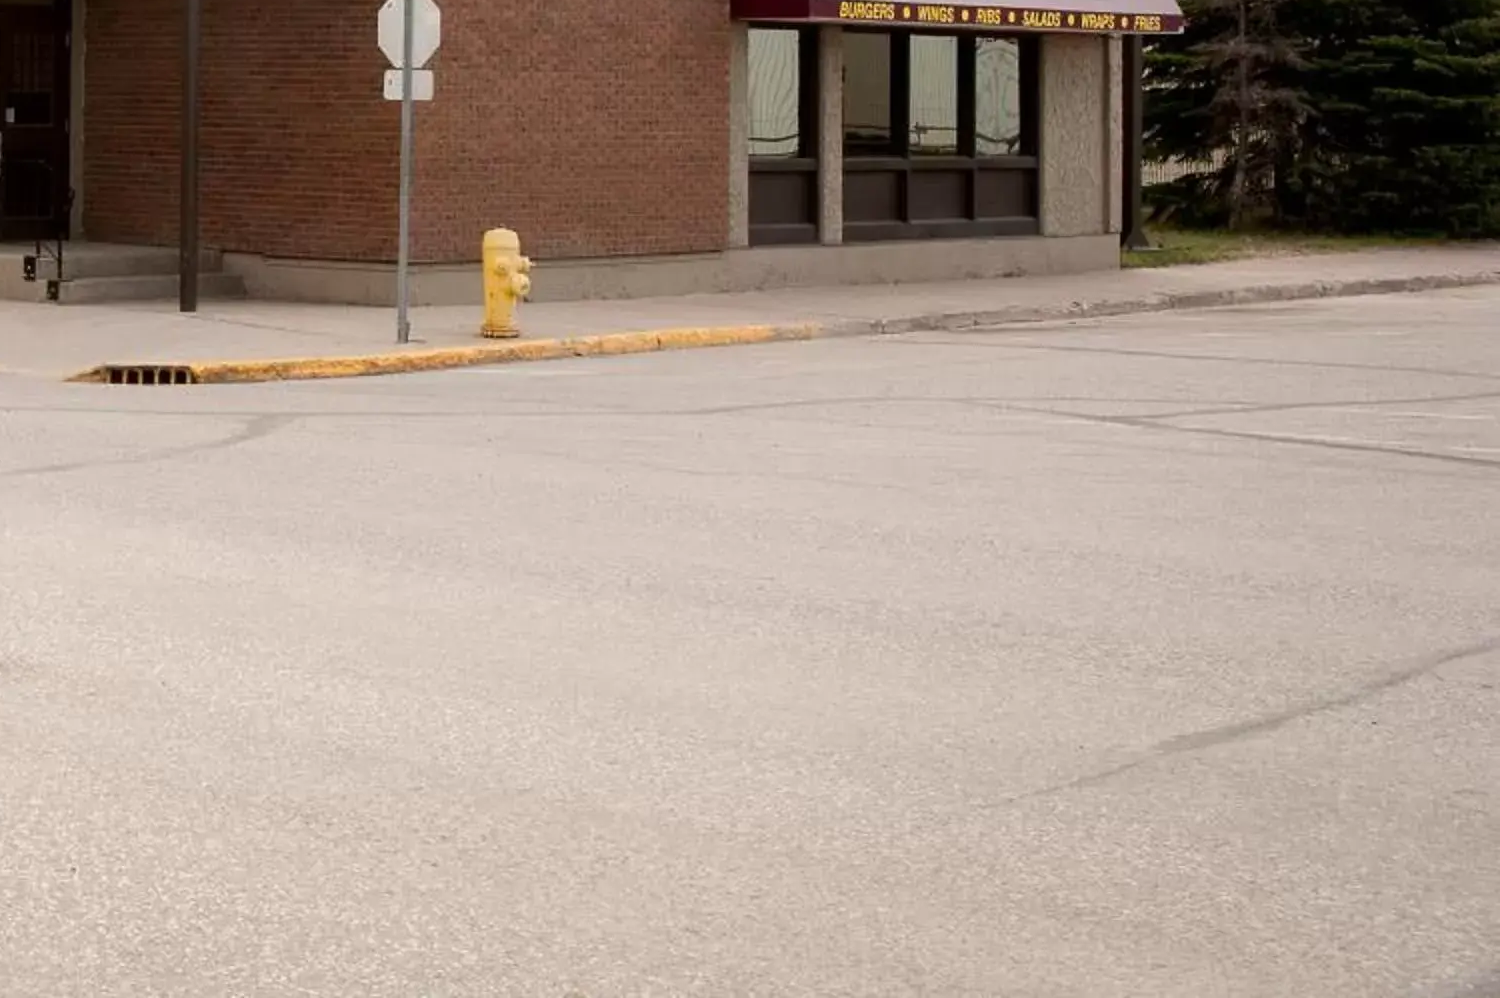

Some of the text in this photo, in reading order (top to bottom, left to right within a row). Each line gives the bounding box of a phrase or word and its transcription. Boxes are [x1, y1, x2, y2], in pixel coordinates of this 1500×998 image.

[839, 1, 1161, 32] BURGERS WINGS RIBS SALADS WRAPS FRIES
